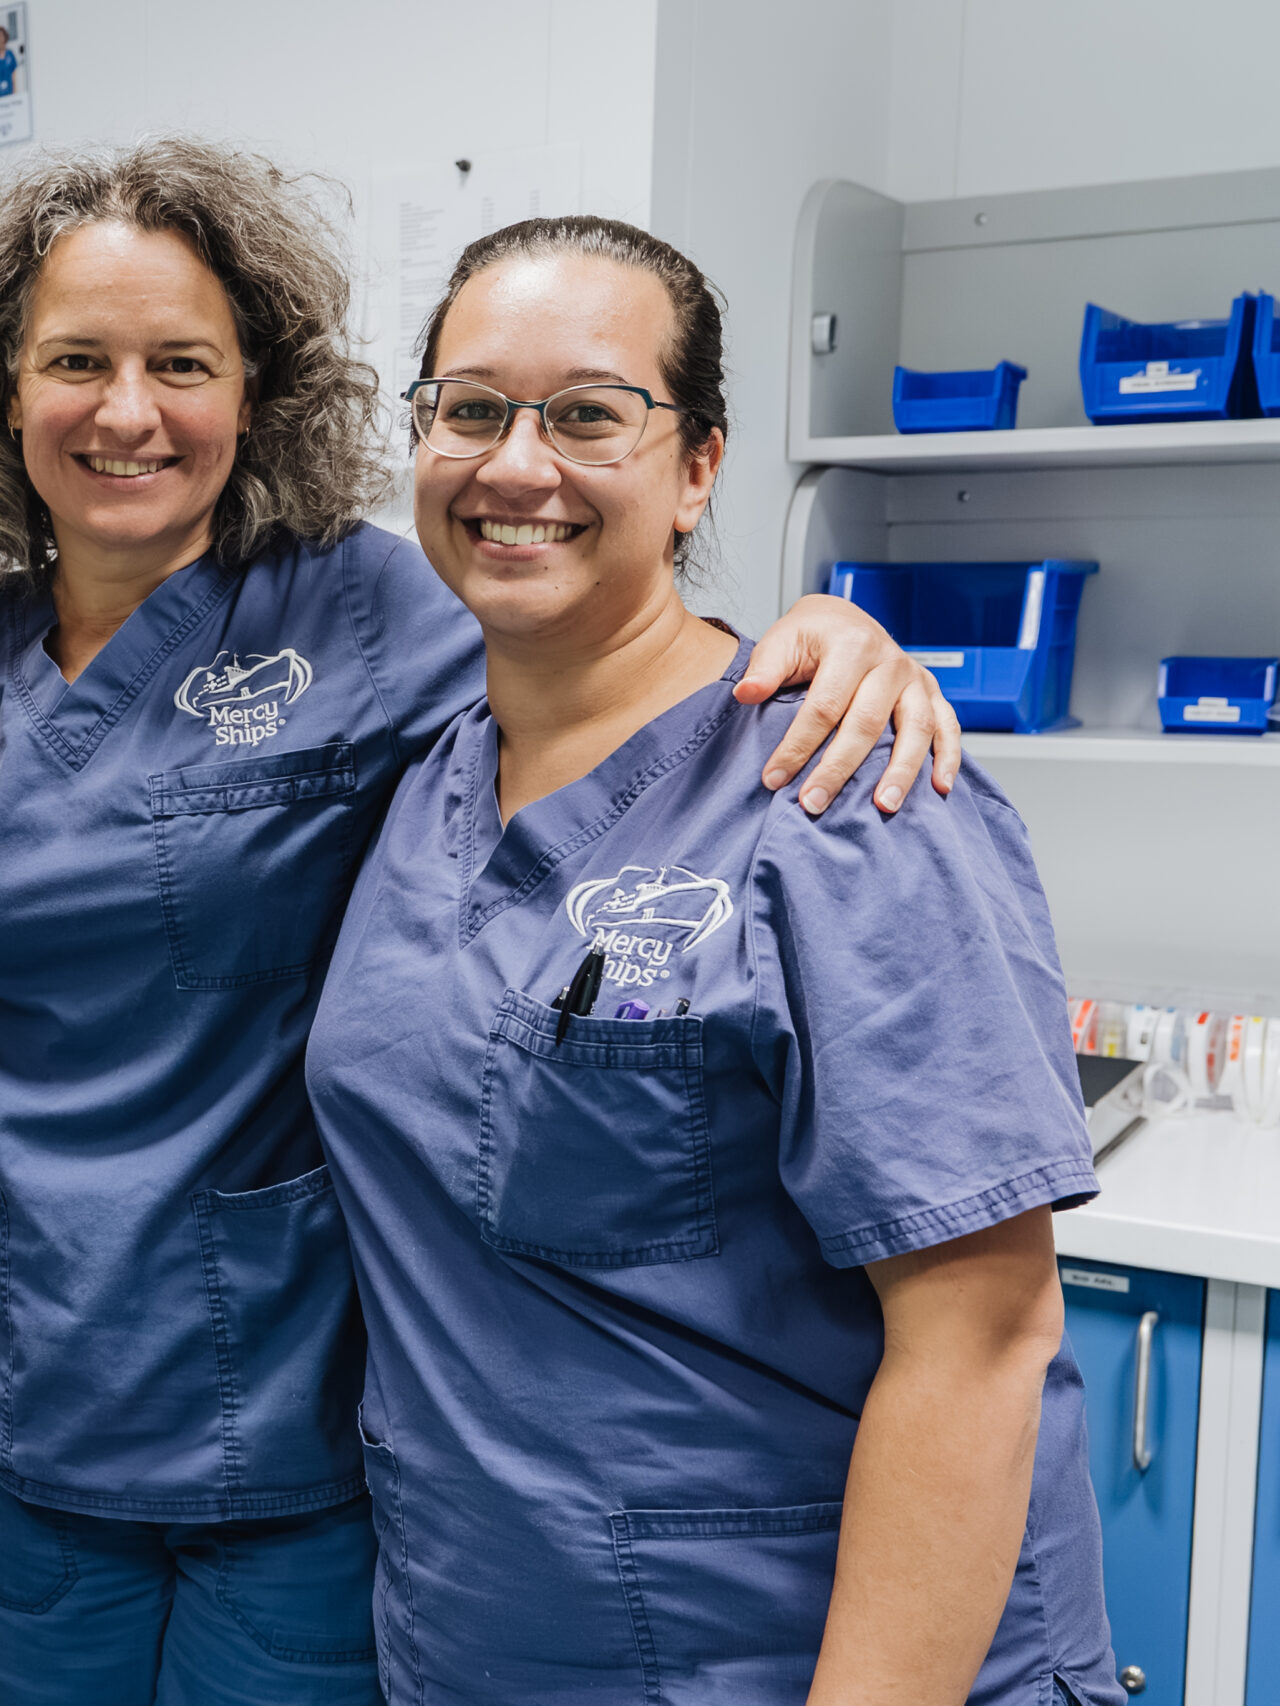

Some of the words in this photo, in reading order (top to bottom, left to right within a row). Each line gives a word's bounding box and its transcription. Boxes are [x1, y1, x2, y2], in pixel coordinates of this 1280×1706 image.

[207, 701, 278, 726] Mercy
[215, 722, 278, 747] Ships
[586, 927, 673, 966] Mercy
[604, 953, 658, 987] hips
